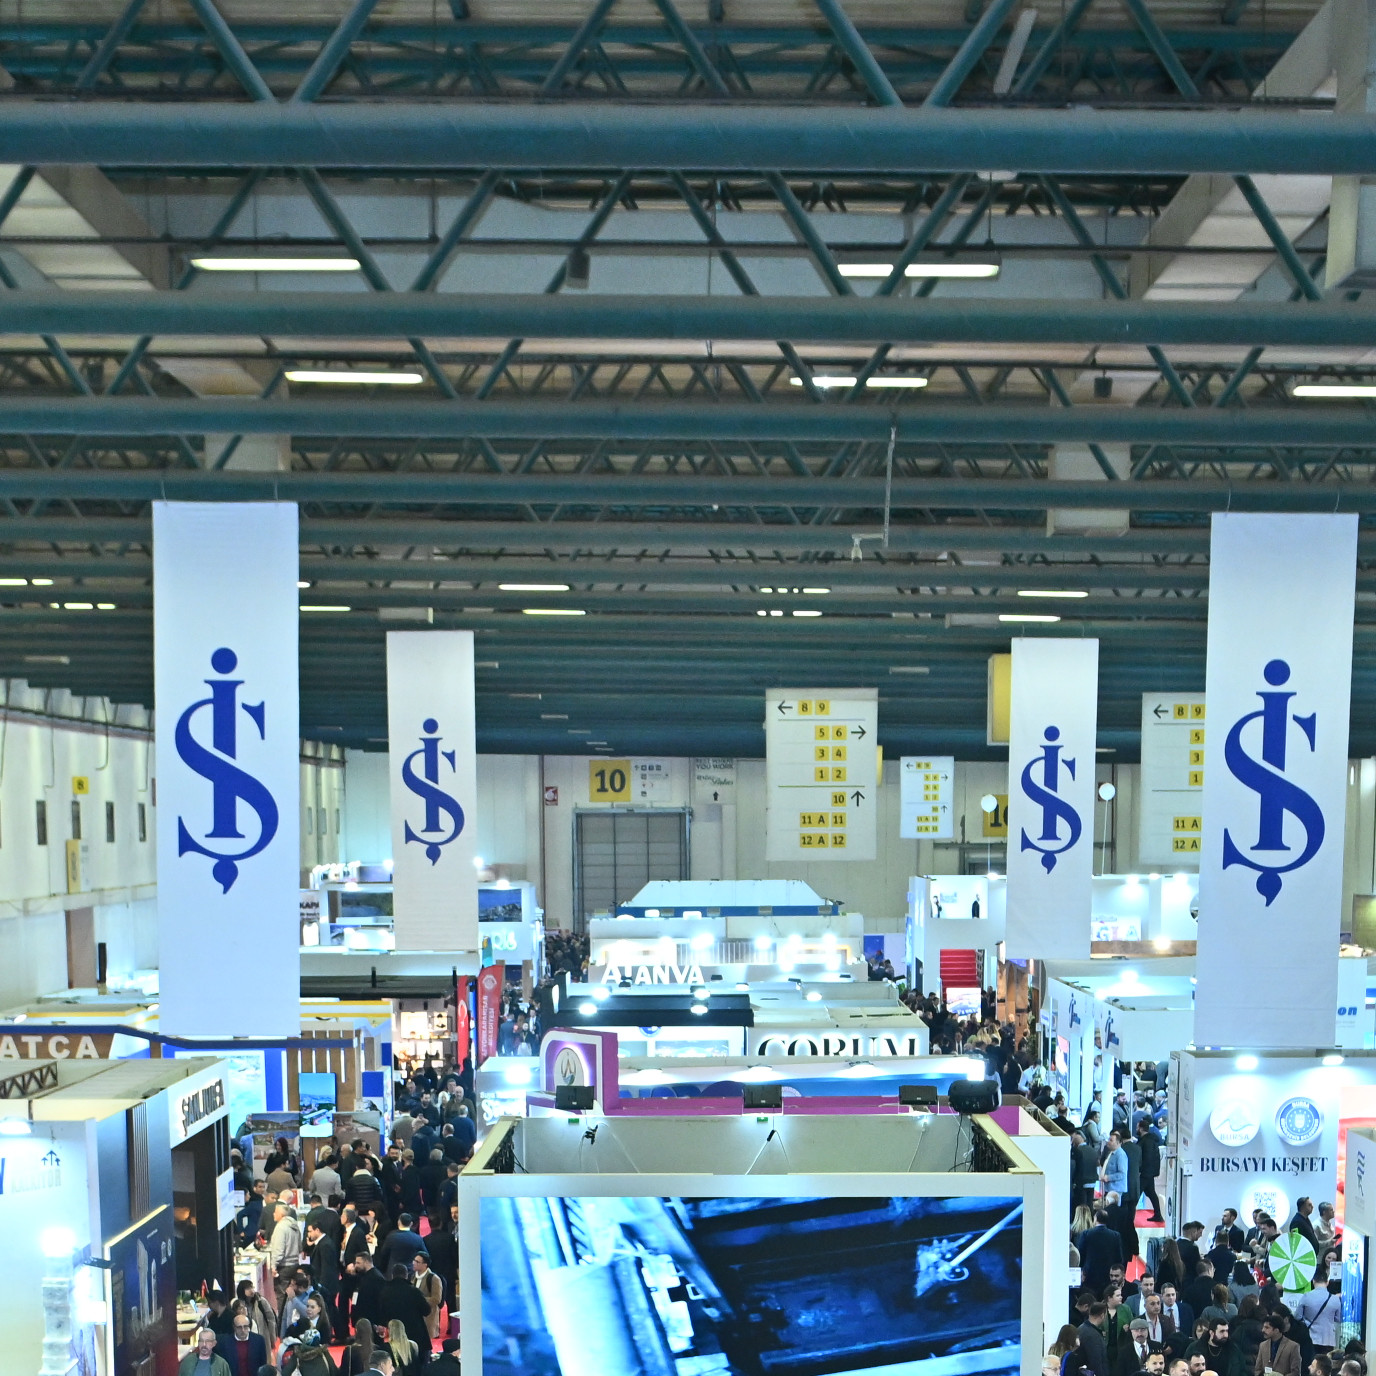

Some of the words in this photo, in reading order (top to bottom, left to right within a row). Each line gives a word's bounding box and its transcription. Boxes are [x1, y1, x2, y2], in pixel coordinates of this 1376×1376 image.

[801, 703, 808, 712] 8
[819, 703, 825, 712] 9
[1178, 707, 1184, 716] 8
[1195, 707, 1201, 716] 9
[819, 728, 825, 737] 5
[836, 728, 842, 737] 6
[1195, 733, 1200, 741] 5
[819, 749, 825, 757] 3
[836, 749, 842, 757] 4
[1194, 754, 1199, 762] 3
[820, 770, 824, 778] 1
[836, 770, 842, 778] 2
[1194, 774, 1198, 782] 1
[595, 769, 626, 792] 10
[834, 795, 845, 804] 10
[802, 816, 812, 824] 11
[818, 816, 825, 824] A
[833, 816, 844, 824] 11
[1175, 820, 1185, 828] 11
[1191, 820, 1198, 828] A
[802, 837, 813, 845] 12
[818, 836, 825, 845] A
[833, 837, 844, 845] 12
[1175, 841, 1185, 849] 12
[1191, 841, 1198, 849] A
[1200, 1157, 1266, 1172] BURSA'YI
[1272, 1157, 1329, 1176] KEŞFET
